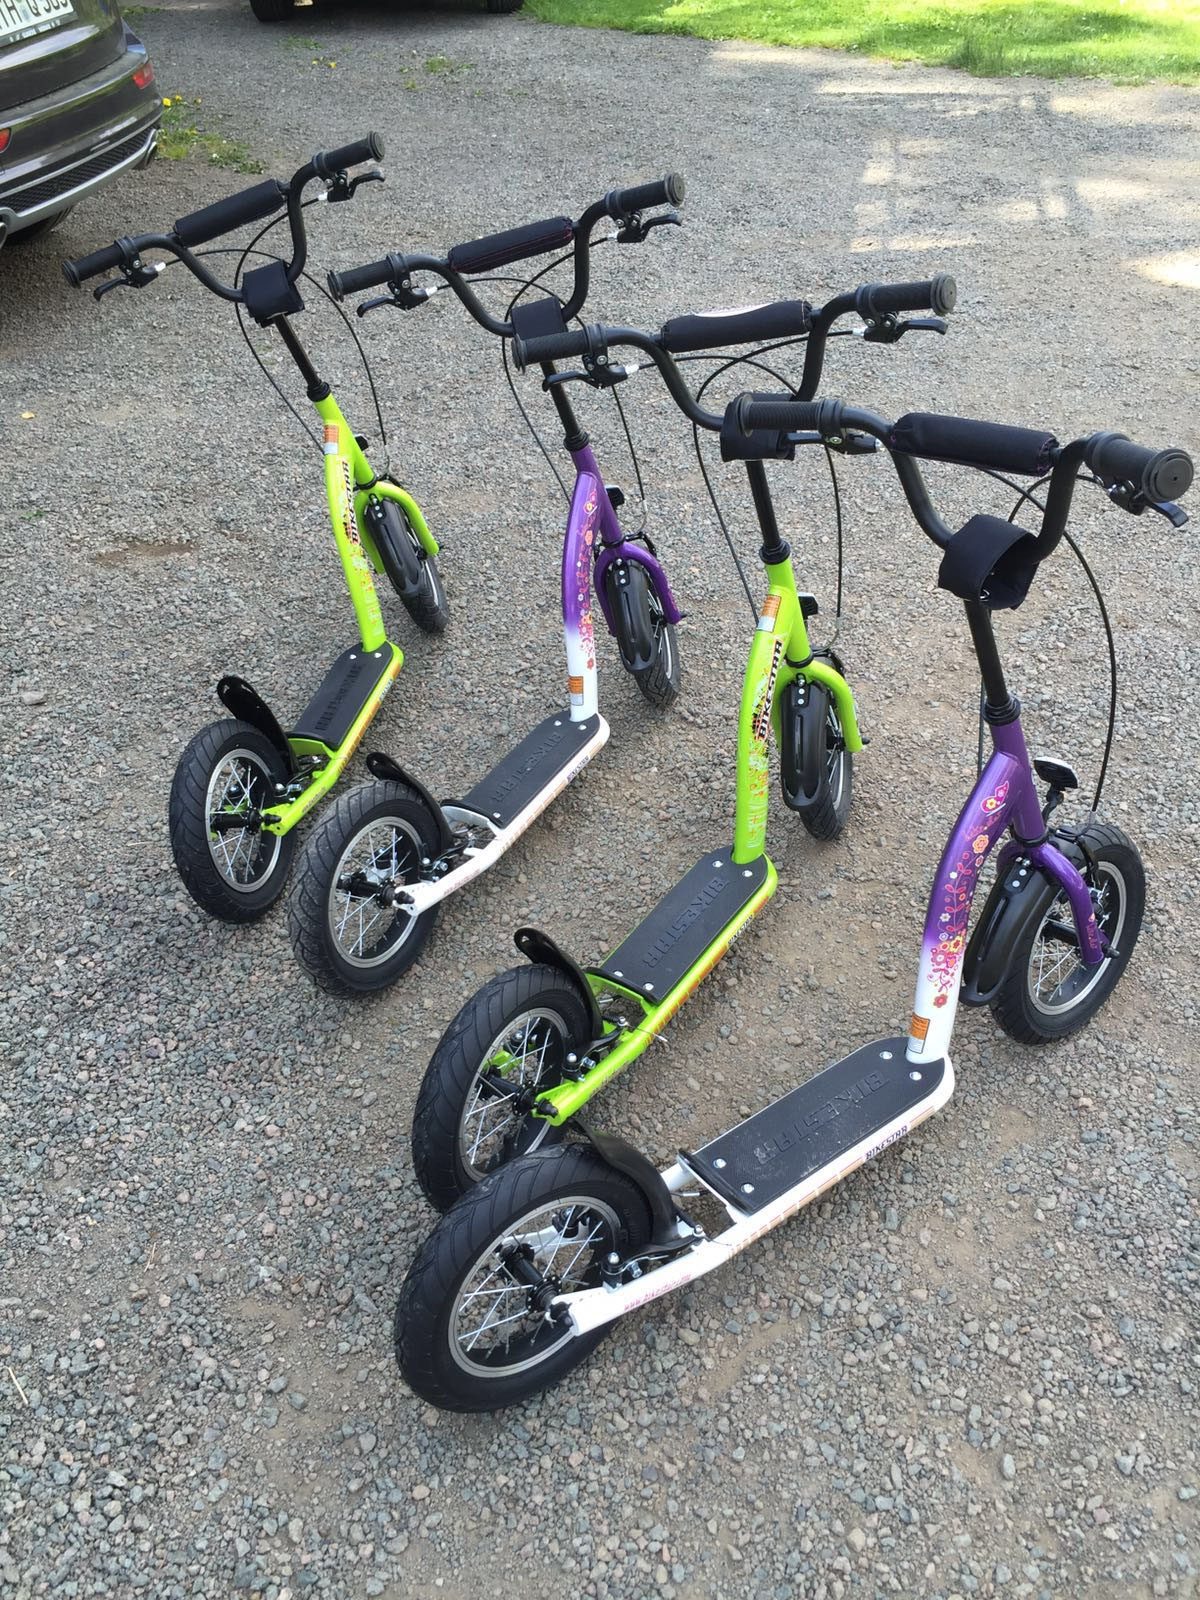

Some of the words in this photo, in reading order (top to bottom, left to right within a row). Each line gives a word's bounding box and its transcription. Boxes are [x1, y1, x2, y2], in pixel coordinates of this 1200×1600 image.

[641, 877, 731, 969] BIKESTAR
[753, 1070, 890, 1165] BIKESTAR
[864, 1124, 909, 1161] BIKESTAR
